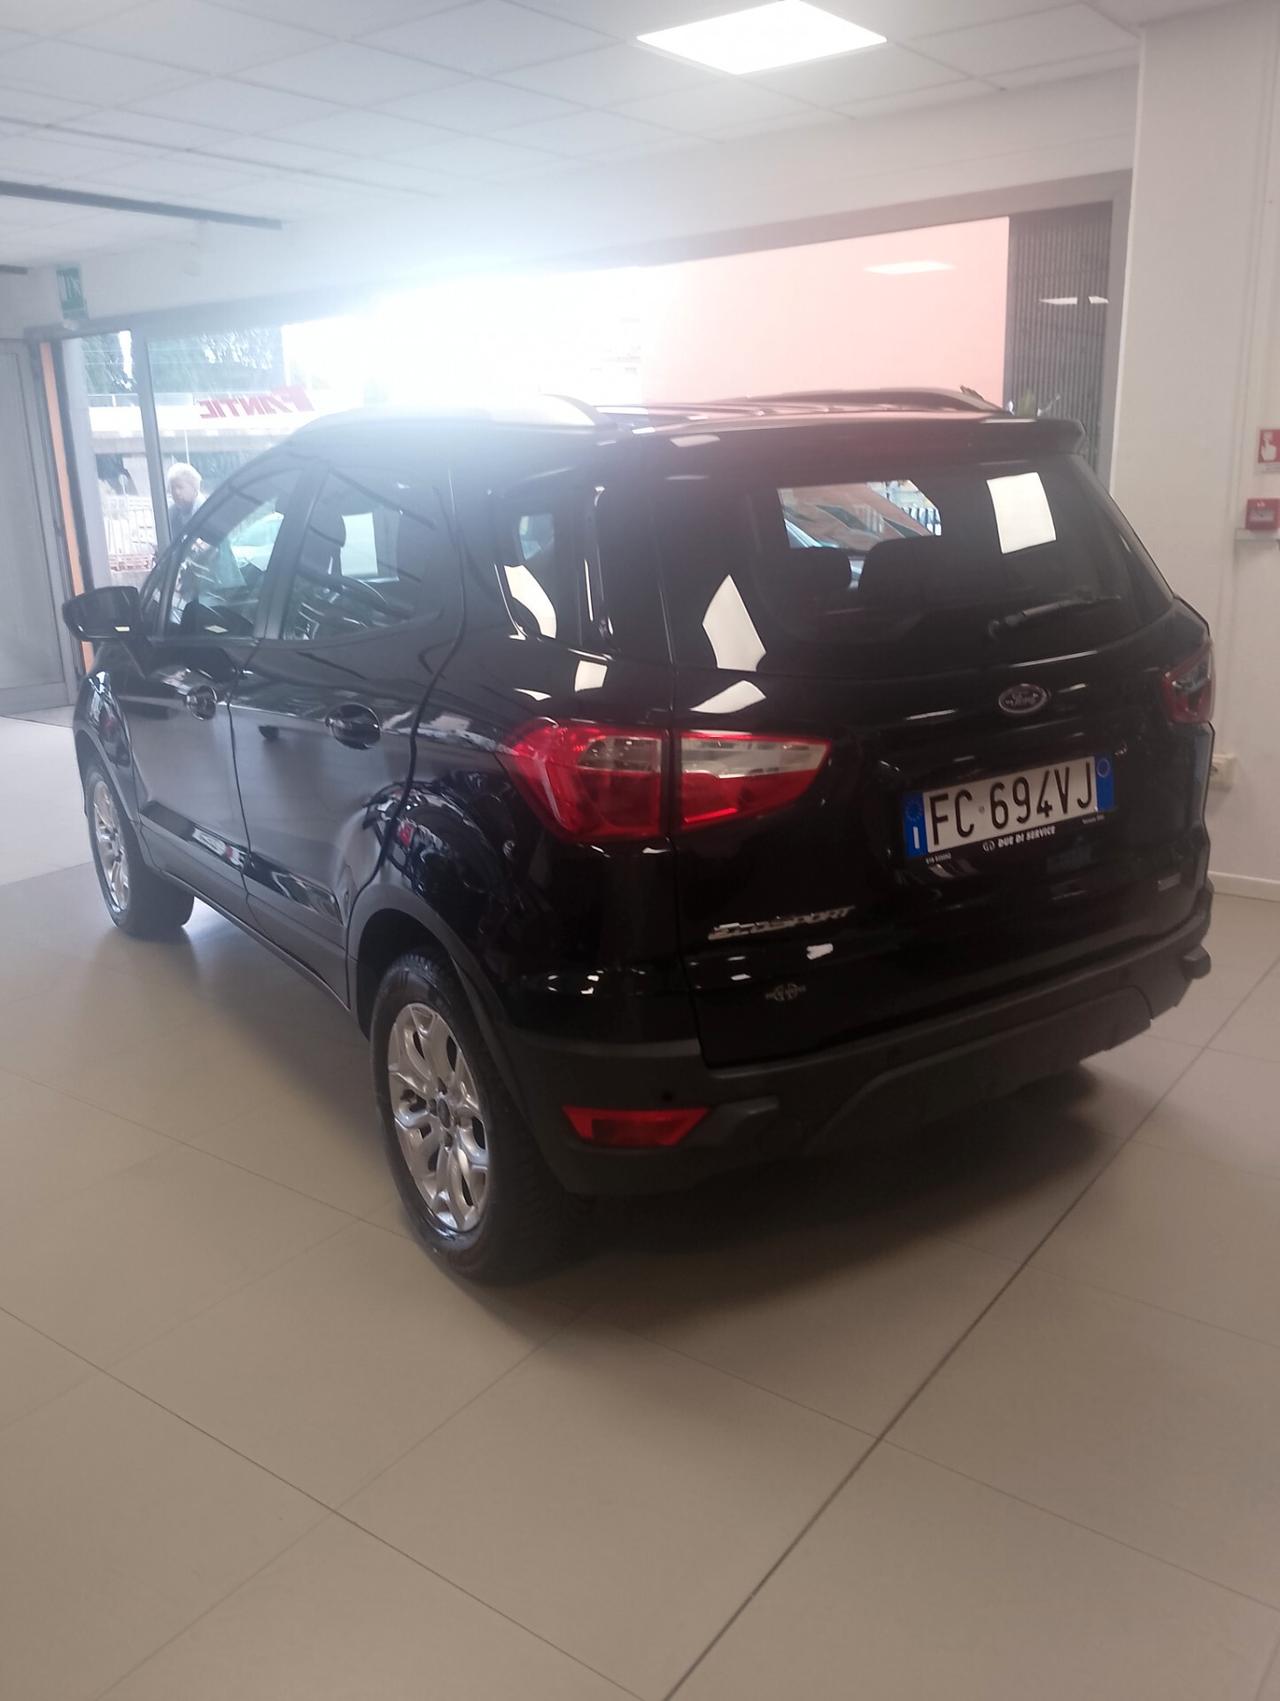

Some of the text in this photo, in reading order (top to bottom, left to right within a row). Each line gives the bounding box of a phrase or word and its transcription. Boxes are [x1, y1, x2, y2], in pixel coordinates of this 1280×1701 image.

[928, 761, 1094, 846] FC 694VJ
[1026, 825, 1056, 842] SERVICE
